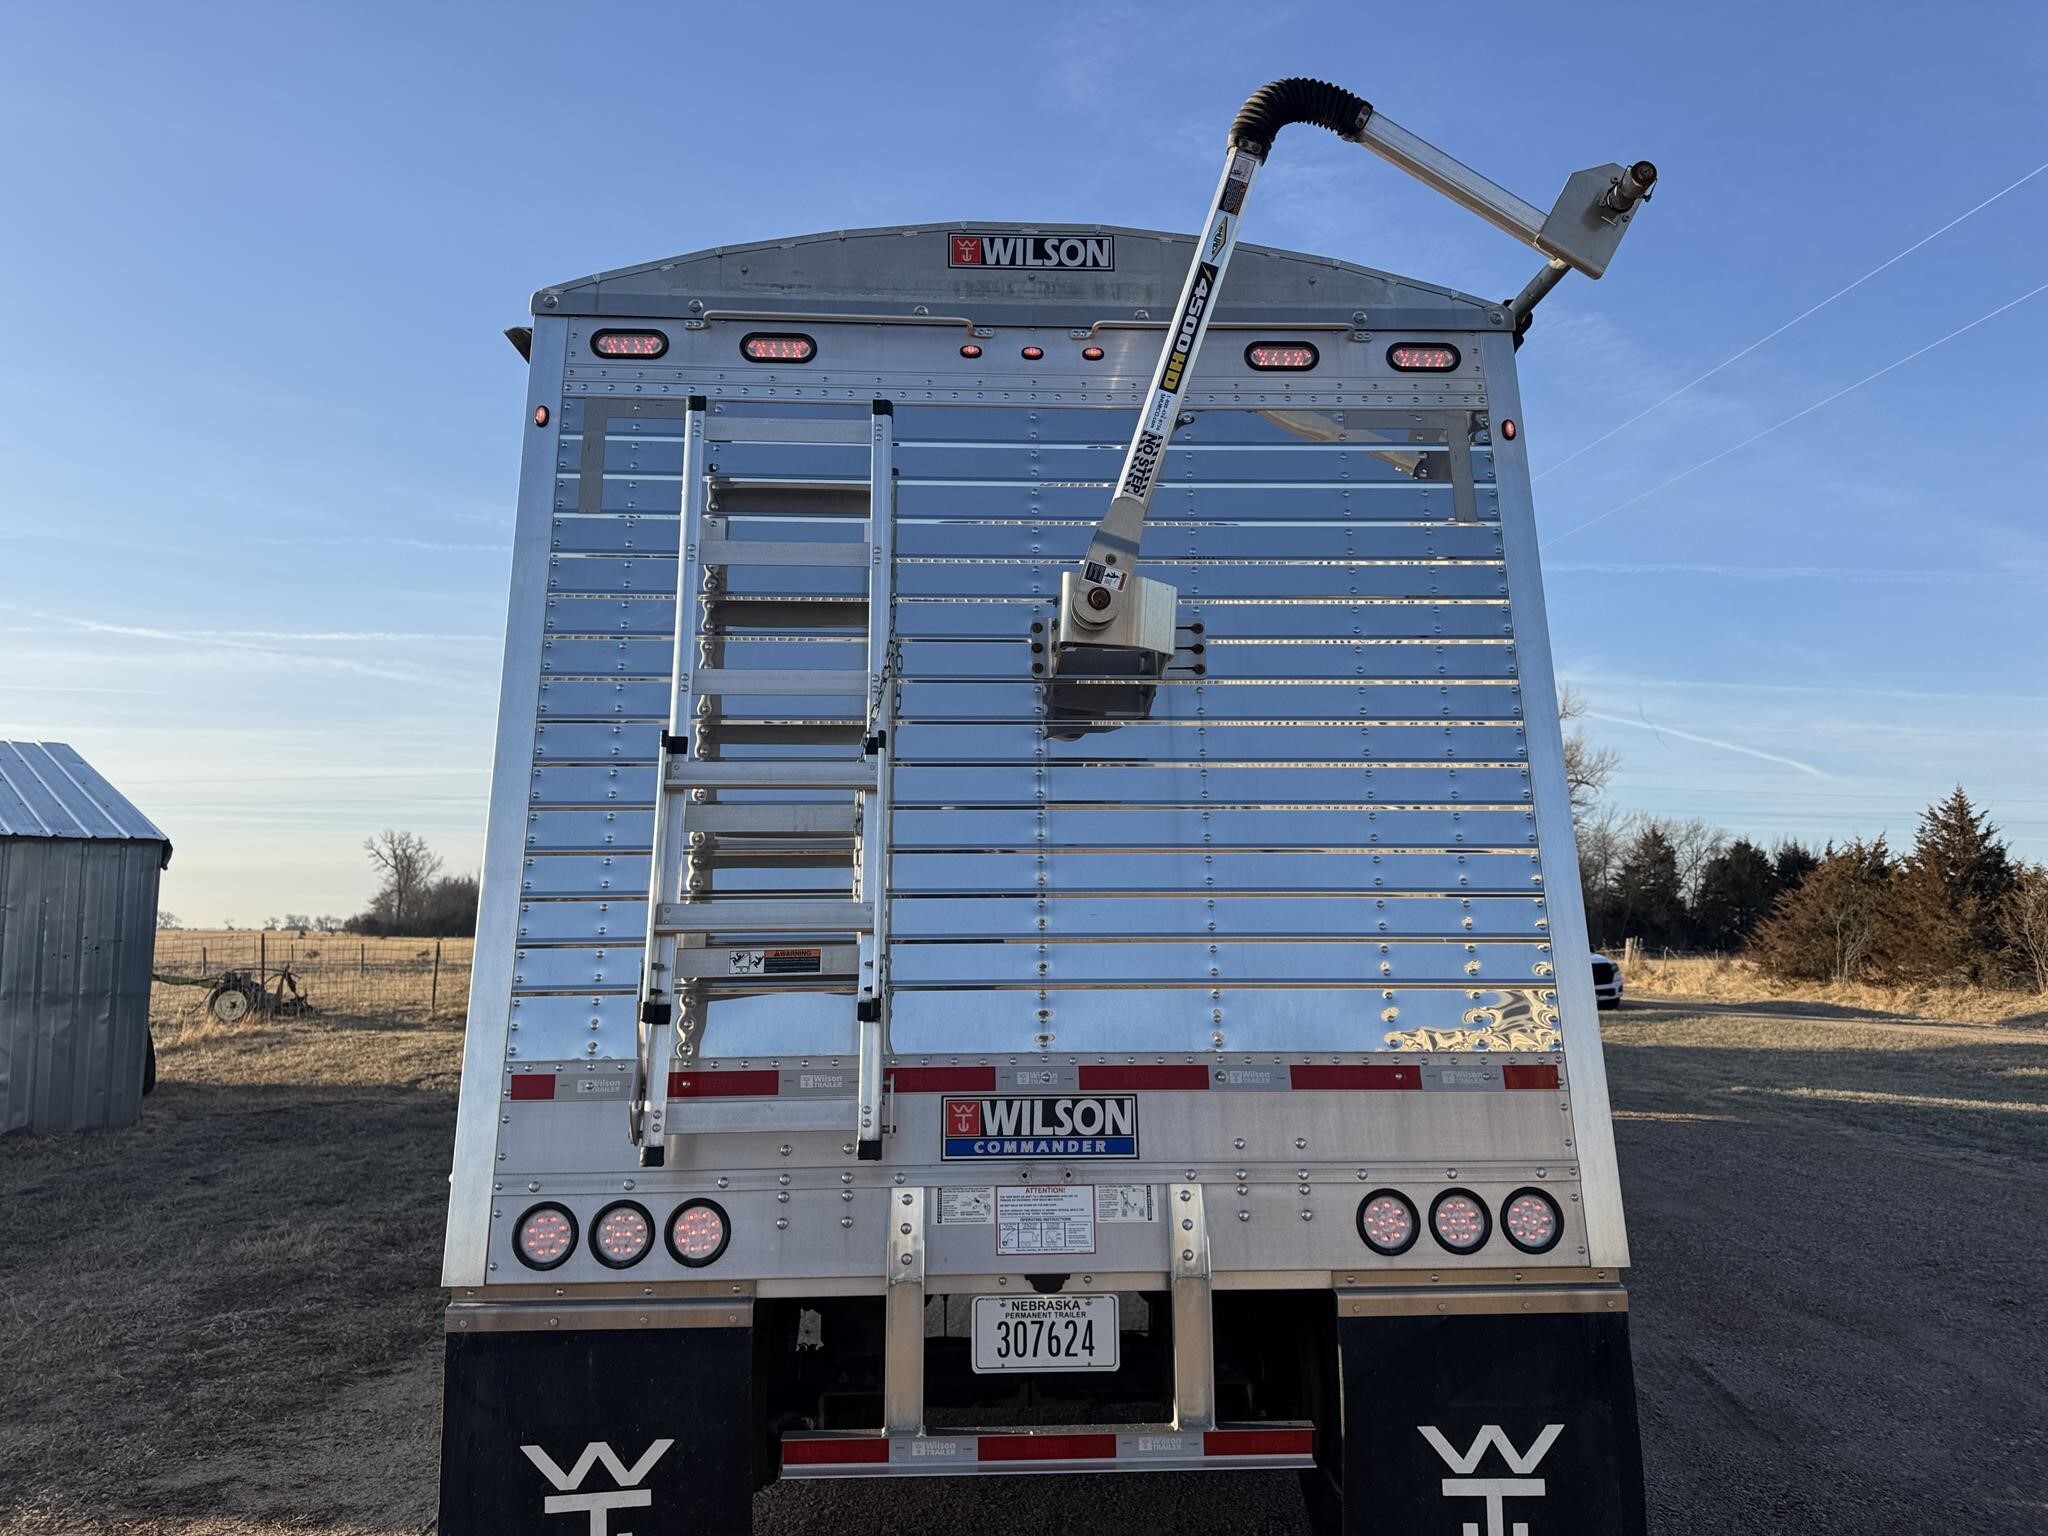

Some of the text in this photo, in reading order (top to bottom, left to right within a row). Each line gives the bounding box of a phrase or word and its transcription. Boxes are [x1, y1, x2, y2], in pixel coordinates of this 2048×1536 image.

[982, 237, 1110, 267] WILSON
[1164, 277, 1208, 390] 4500HD
[1131, 431, 1160, 494] NO STEP
[982, 1099, 1132, 1136] WILSON
[973, 1140, 1106, 1154] COMMANDER
[1011, 1300, 1081, 1311] NEBRASKA
[1055, 1311, 1087, 1319] TRAILER
[996, 1320, 1095, 1358] 307624
